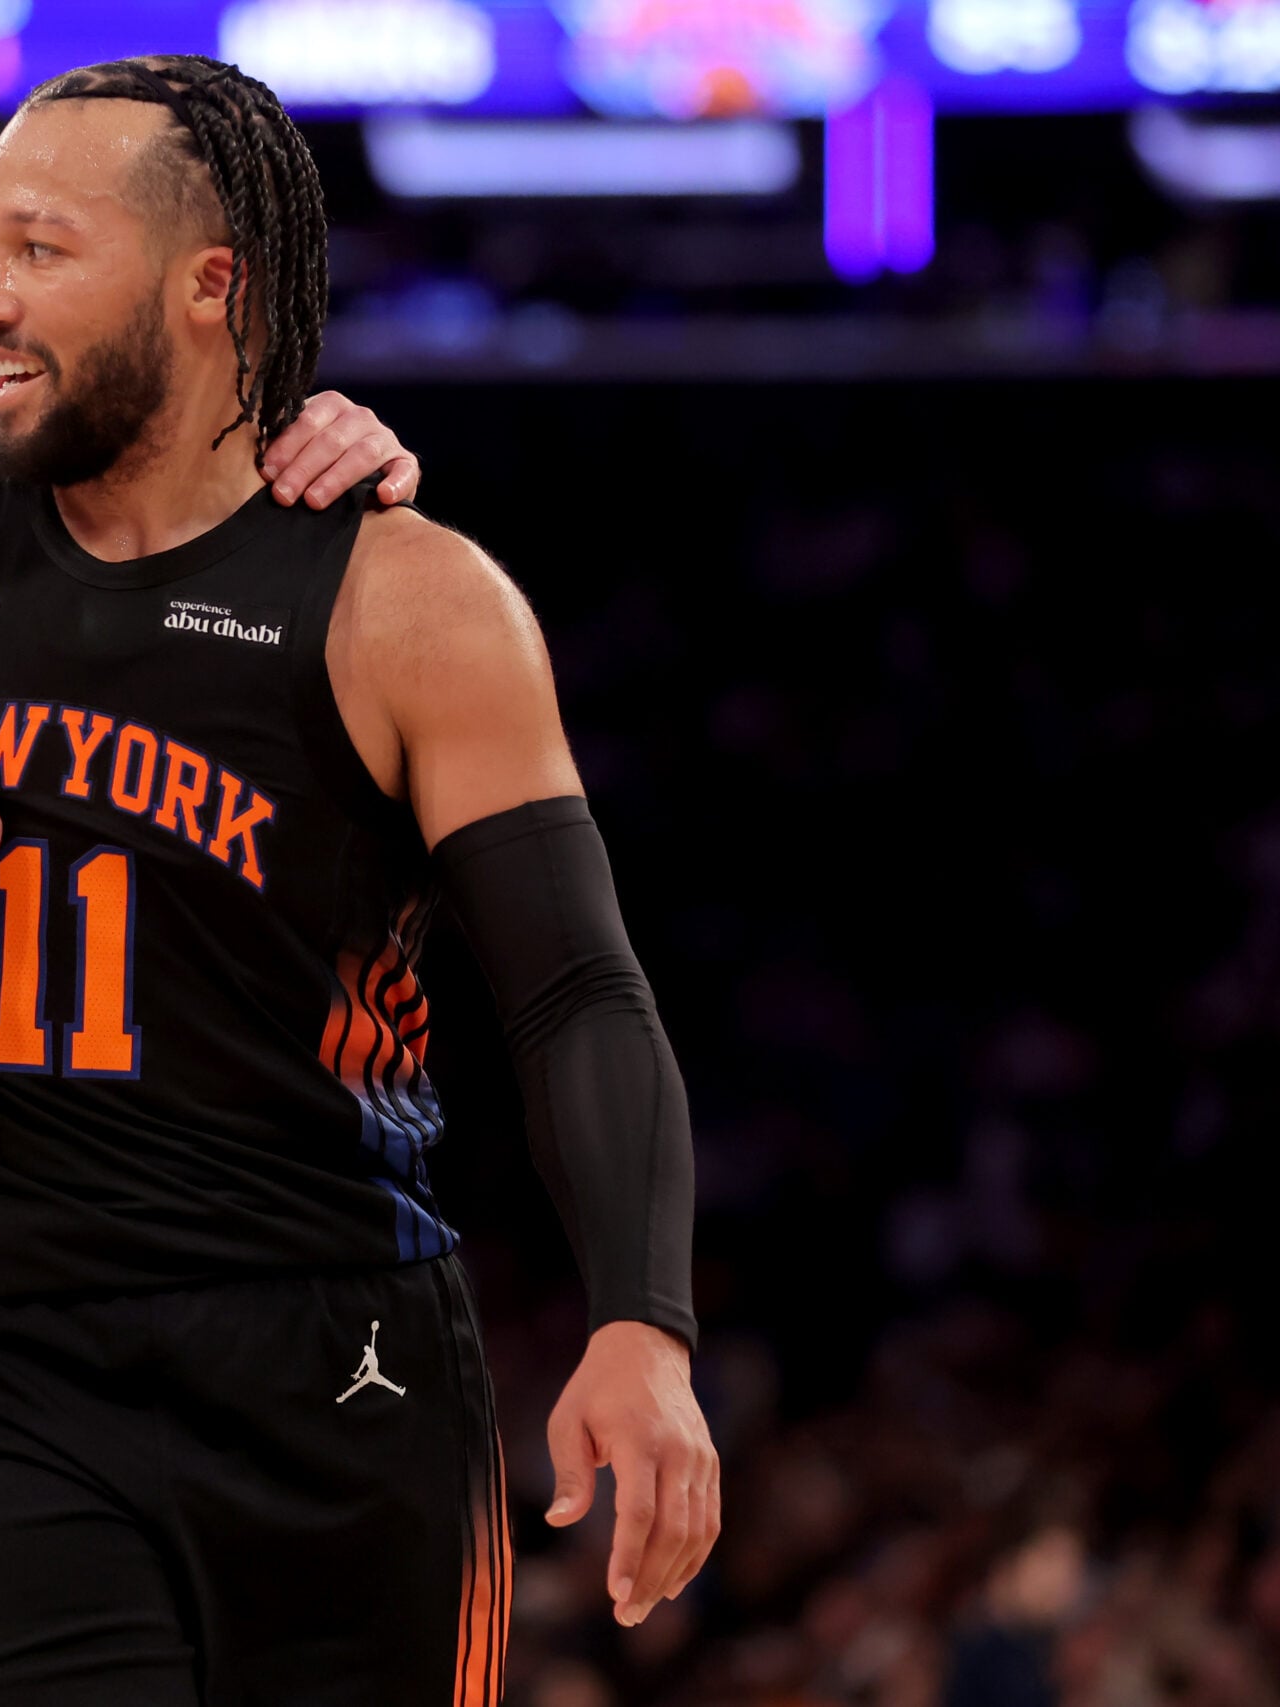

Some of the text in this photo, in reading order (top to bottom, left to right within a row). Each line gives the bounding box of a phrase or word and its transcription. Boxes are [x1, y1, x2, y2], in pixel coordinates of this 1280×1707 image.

[170, 600, 232, 616] experience
[163, 611, 283, 645] abu dhabi
[59, 704, 277, 893] YORK
